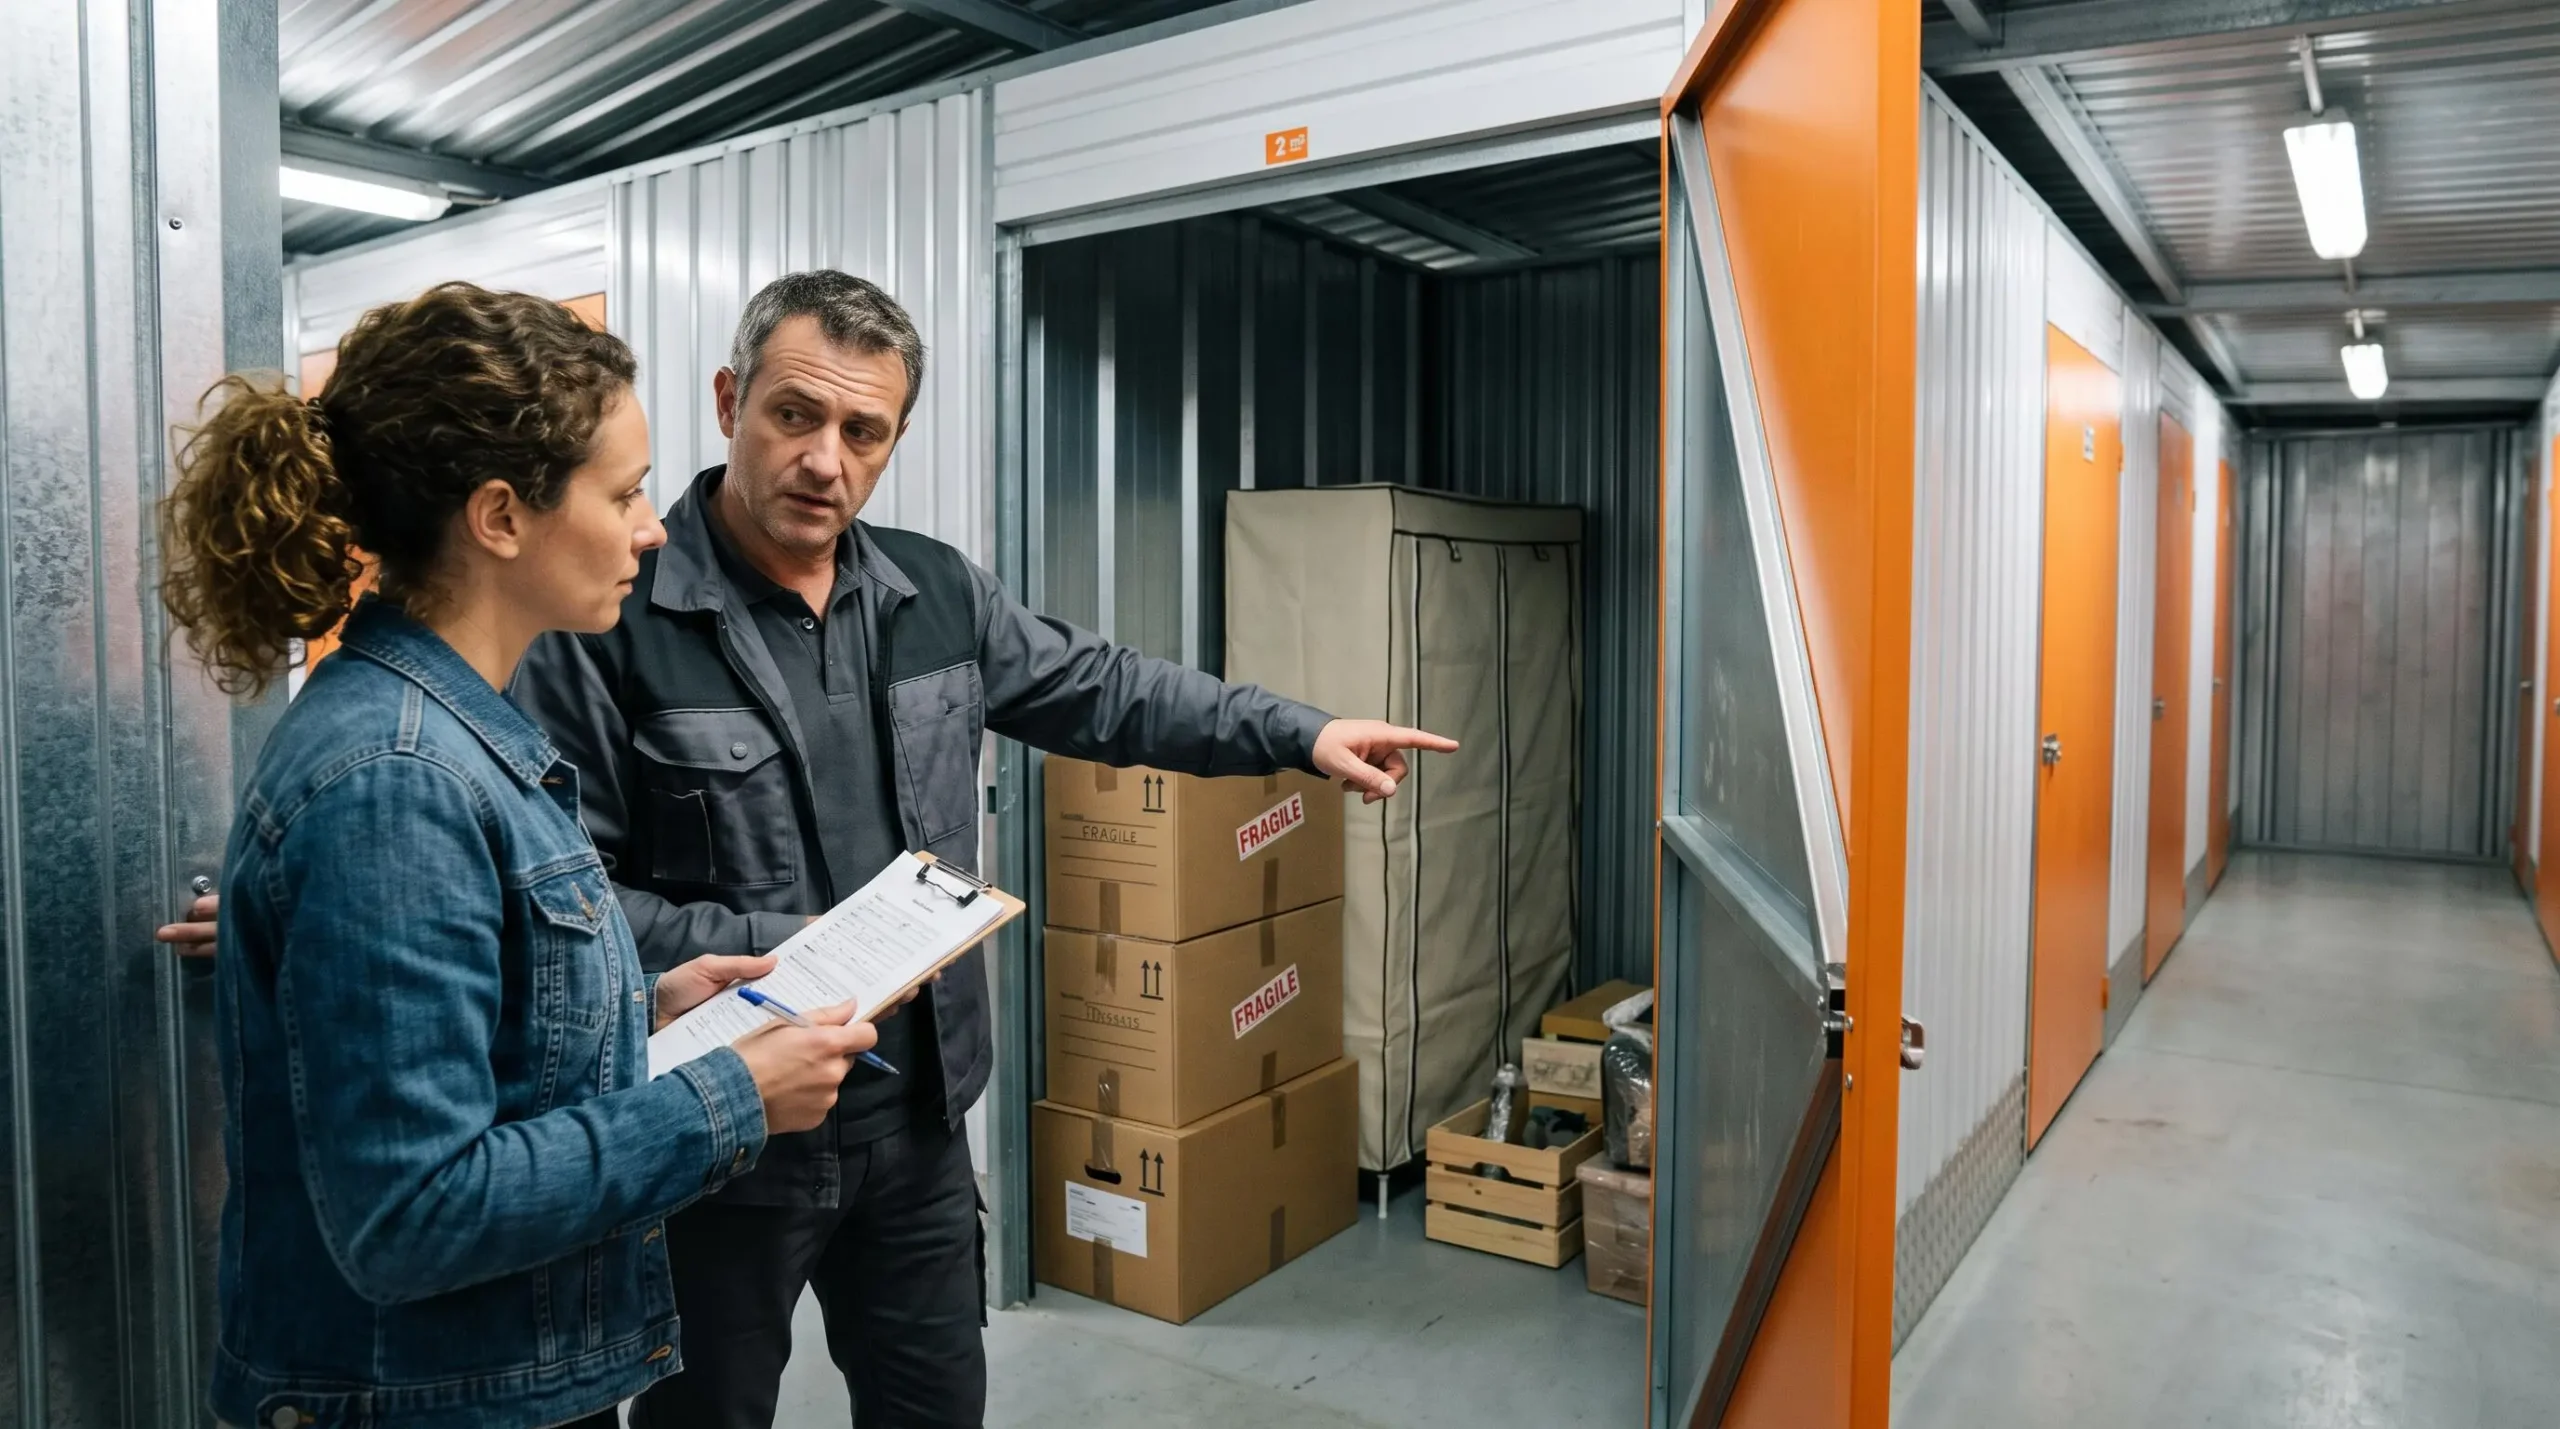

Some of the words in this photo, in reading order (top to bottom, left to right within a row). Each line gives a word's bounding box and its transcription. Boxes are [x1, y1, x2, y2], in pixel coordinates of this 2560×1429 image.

[1275, 136, 1286, 157] 2
[1082, 825, 1137, 843] FRAGILE
[1239, 798, 1302, 853] FRAGILE
[1235, 970, 1297, 1032] FRAGILE
